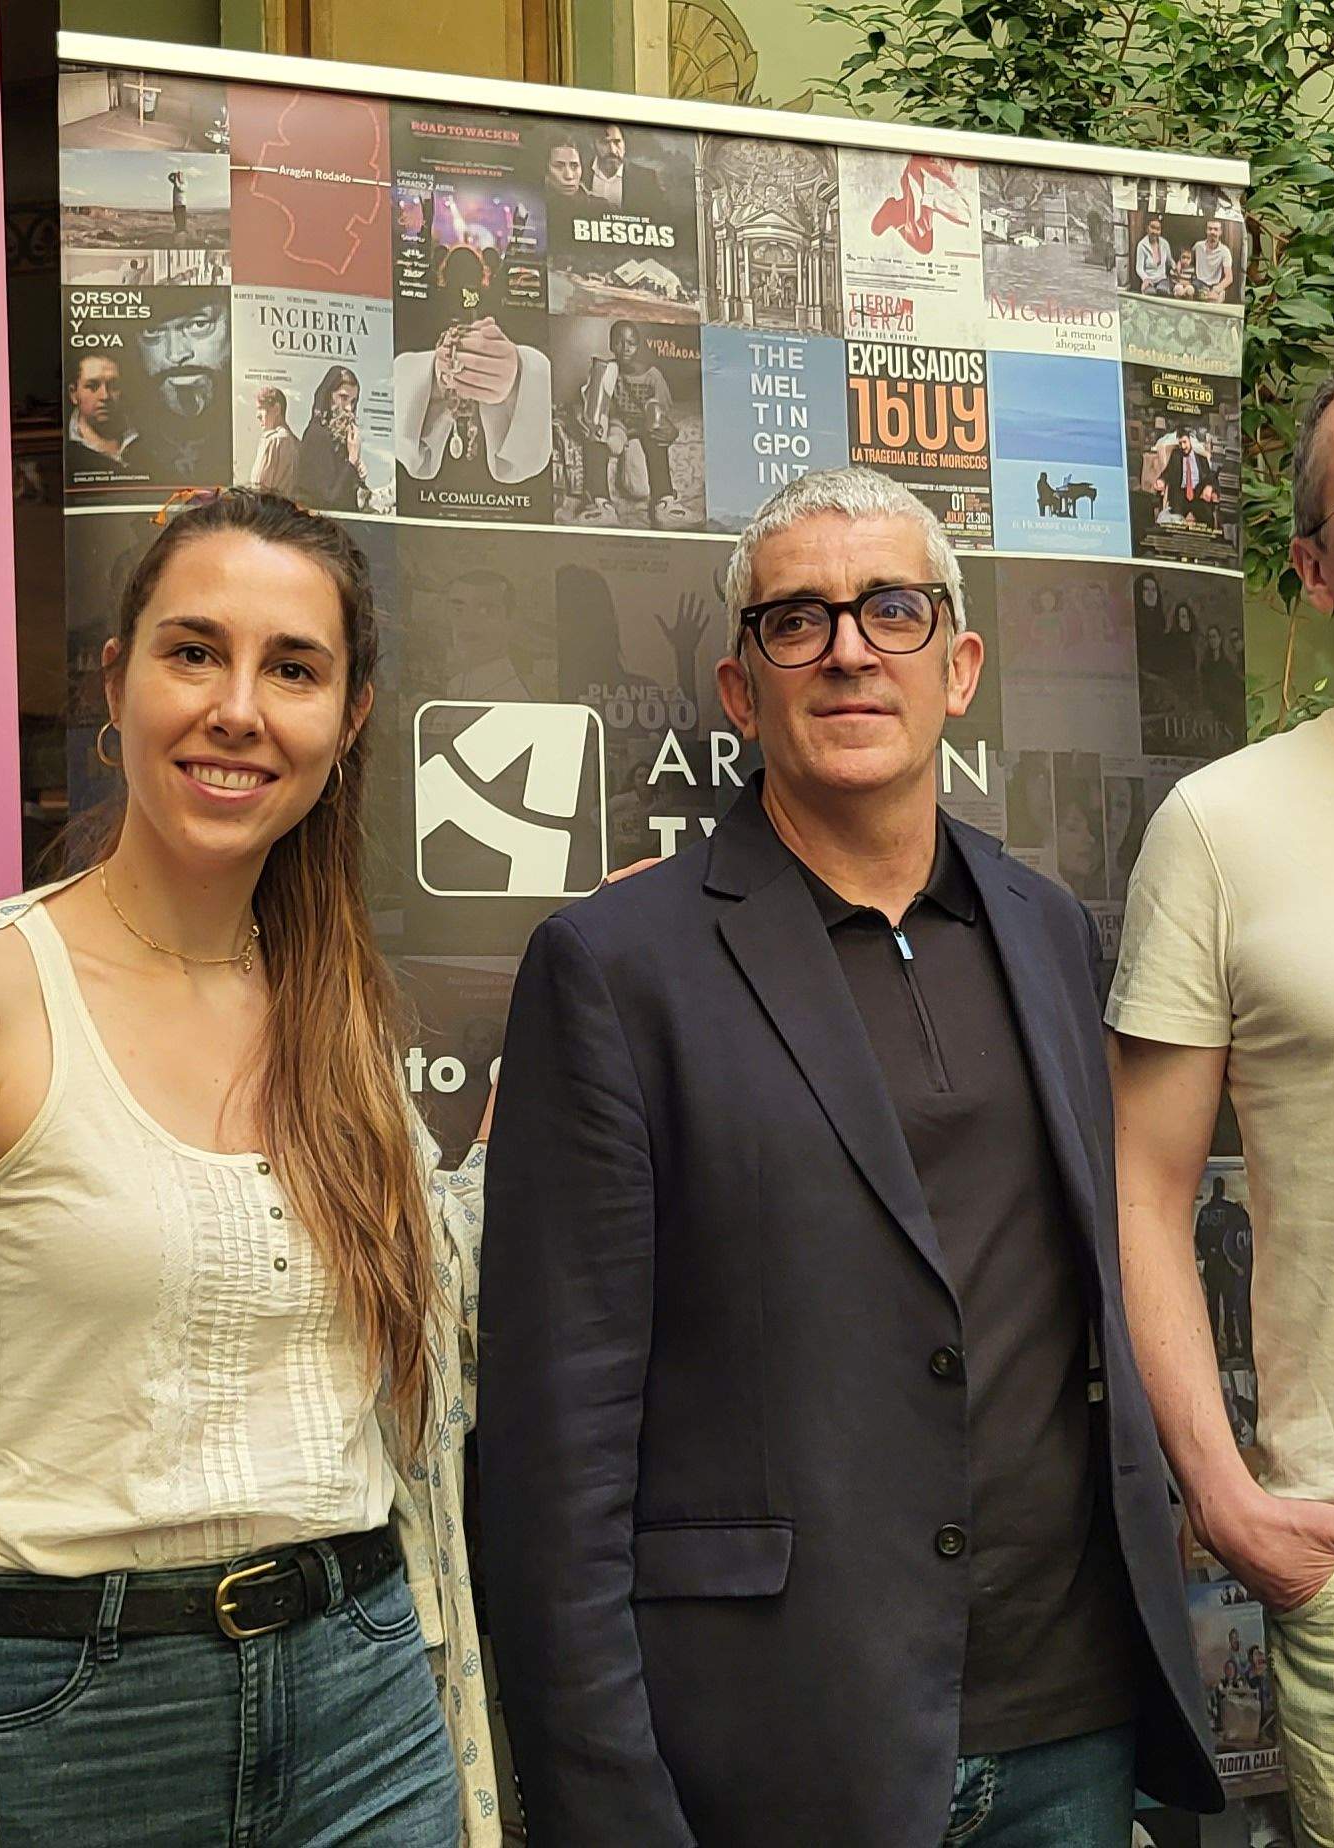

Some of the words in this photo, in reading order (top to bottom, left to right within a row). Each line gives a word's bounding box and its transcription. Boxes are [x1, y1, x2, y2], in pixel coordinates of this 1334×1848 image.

[279, 165, 313, 179] Aragón
[315, 169, 352, 183] Rodado
[573, 219, 675, 248] BIESCAS
[71, 290, 142, 306] ORSON
[71, 305, 151, 319] WELLES
[988, 290, 1114, 330] Mediano
[71, 320, 83, 333] Y
[259, 306, 369, 336] INCIERTA
[71, 334, 124, 348] GOYA
[272, 329, 357, 356] GLORIA
[646, 338, 675, 350] VIDAS
[1055, 327, 1068, 339] La
[1070, 330, 1113, 342] memoria
[1055, 340, 1096, 353] ahogada
[749, 344, 804, 370] THE
[848, 341, 984, 385] EXPULSADOS
[750, 373, 807, 399] MEL
[1154, 383, 1165, 395] EL
[1167, 385, 1212, 402] TRASTERO
[752, 402, 808, 429] TIN
[849, 377, 987, 453] 1609
[753, 432, 810, 458] GPO
[852, 446, 863, 462] LA
[864, 448, 907, 466] TRAGEDIA
[908, 451, 920, 466] DE
[921, 453, 938, 468] LOS
[940, 454, 988, 470] MORISCOS
[420, 490, 436, 502] LA
[438, 492, 531, 507] COMULGANTE
[951, 493, 965, 512] 01
[588, 683, 686, 700] PLANETA
